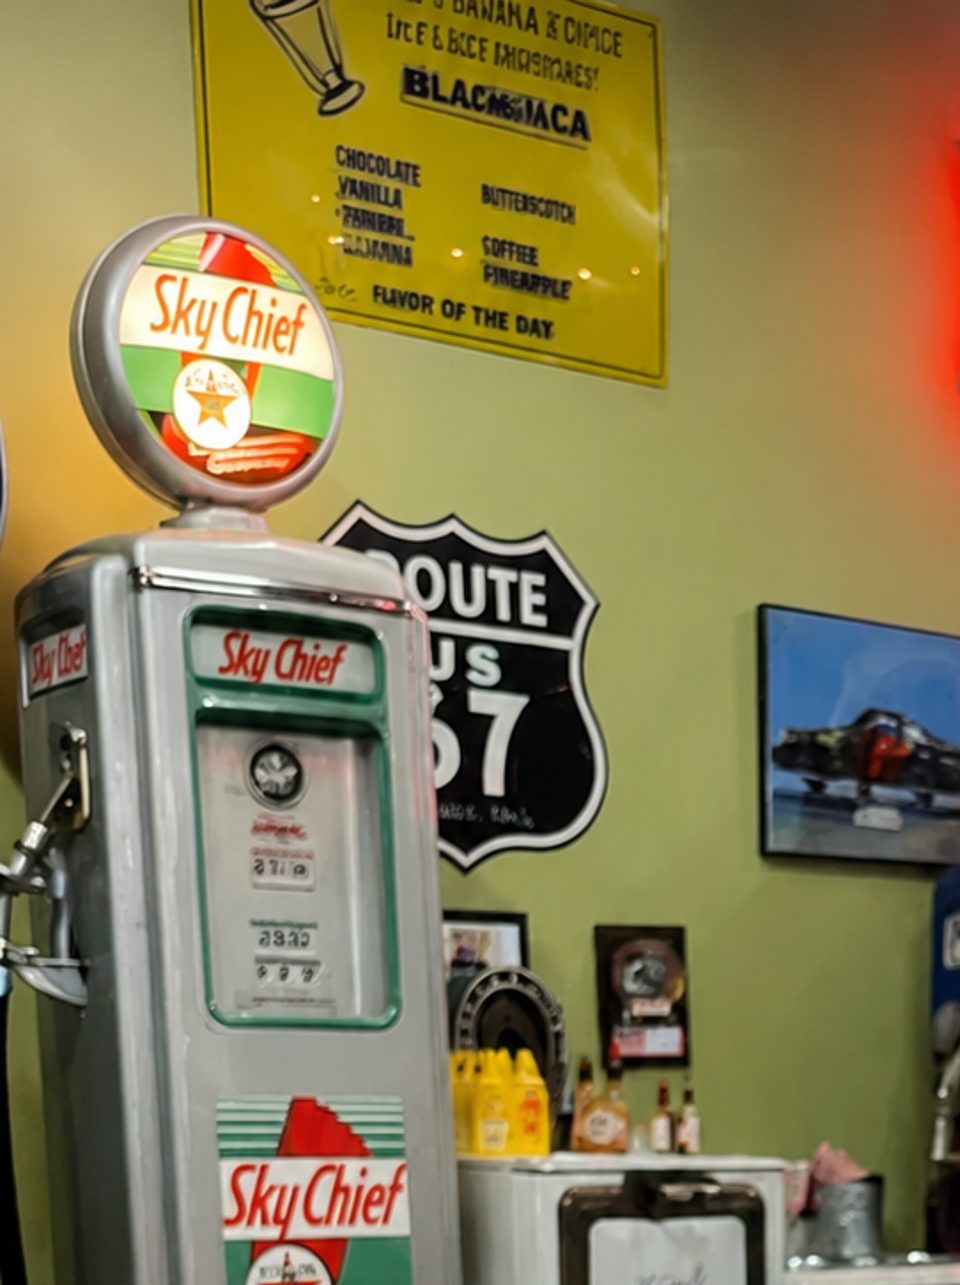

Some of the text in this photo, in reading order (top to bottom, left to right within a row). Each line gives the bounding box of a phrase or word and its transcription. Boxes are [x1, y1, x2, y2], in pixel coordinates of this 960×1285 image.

[335, 144, 421, 188] CHOCOLATE
[338, 175, 403, 210] VANILLA
[150, 273, 307, 356] Sky Chief
[373, 285, 555, 340] FLAVOR OF THE DAY
[366, 549, 548, 628] OUTE
[217, 629, 347, 686] Sky Chief
[222, 1162, 408, 1242] Sky Chief
